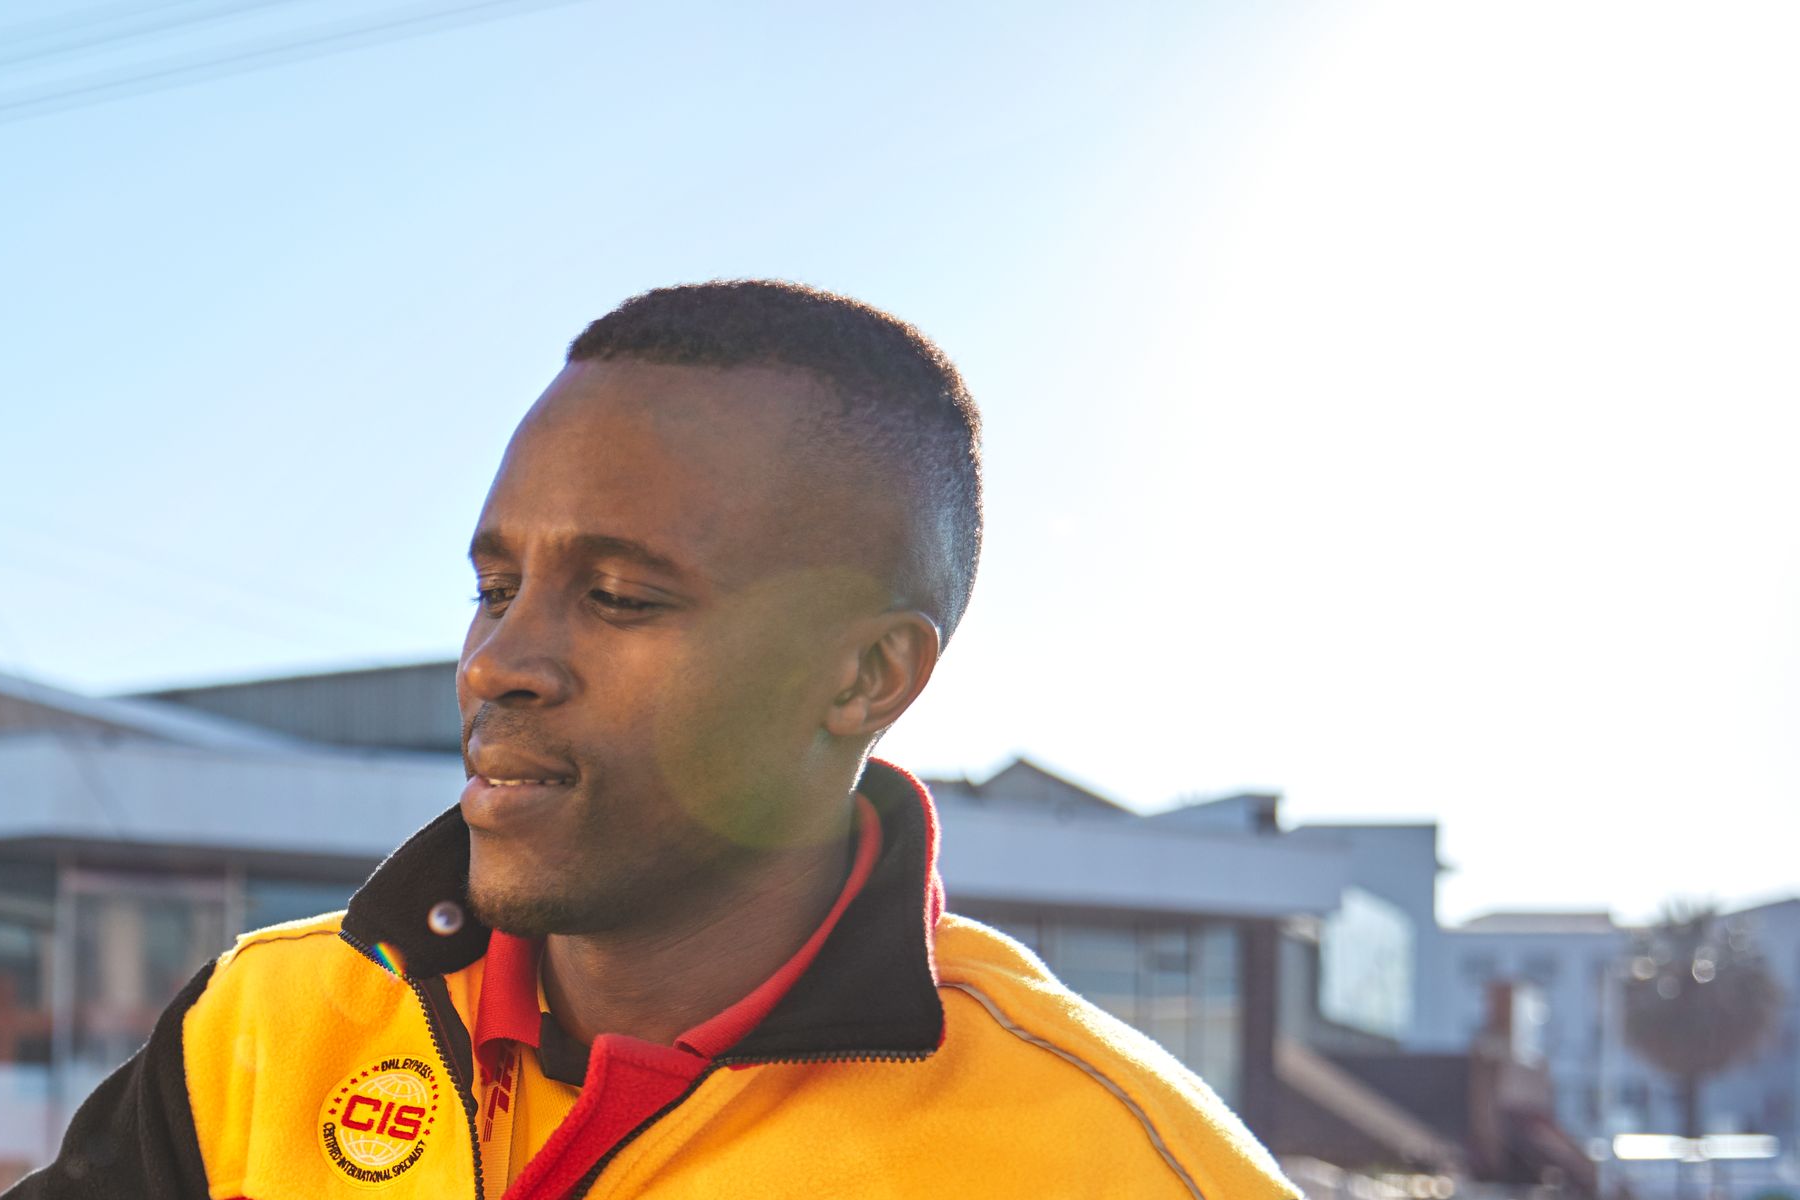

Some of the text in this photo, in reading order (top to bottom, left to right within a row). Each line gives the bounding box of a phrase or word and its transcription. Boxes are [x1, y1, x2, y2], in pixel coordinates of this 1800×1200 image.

[381, 1058, 433, 1079] DHL EXPRESS
[341, 1094, 426, 1141] CIS
[323, 1122, 426, 1183] CERTIFIED INTERNATIONAL SPECIALIST
